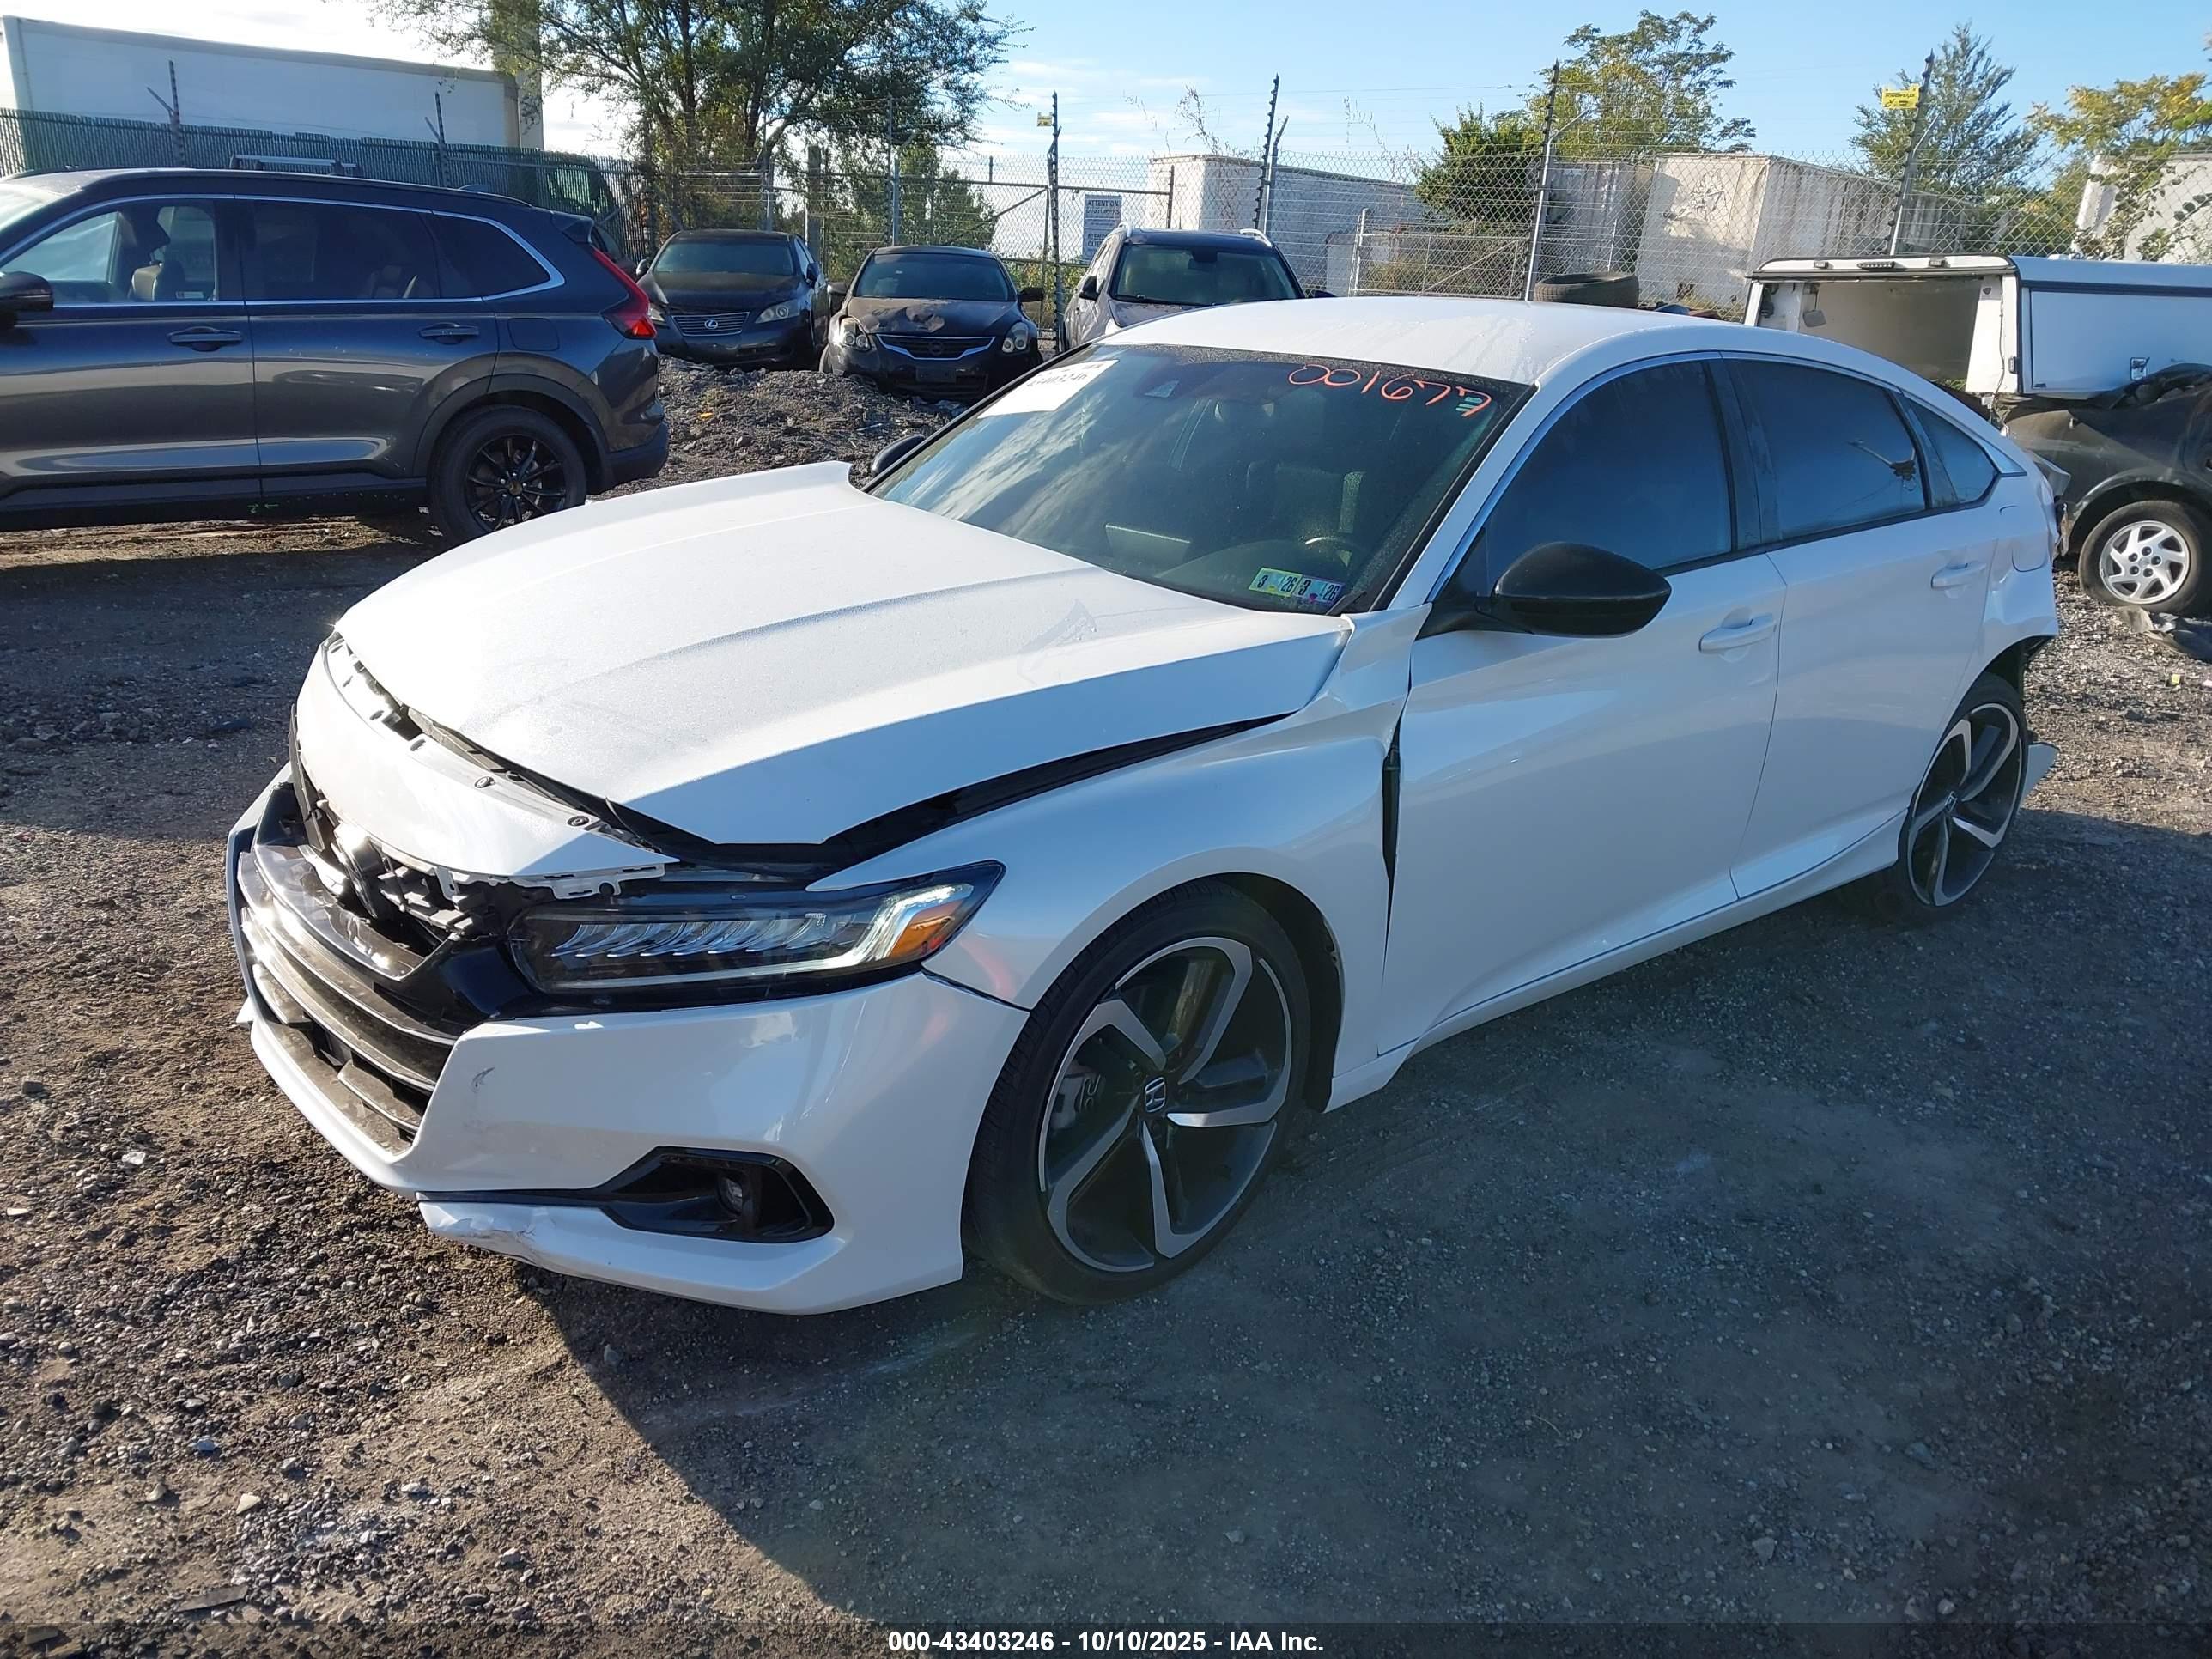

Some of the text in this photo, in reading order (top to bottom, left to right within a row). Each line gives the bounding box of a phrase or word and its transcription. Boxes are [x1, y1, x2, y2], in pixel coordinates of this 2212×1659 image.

[1257, 575, 1297, 592] 3 26
[1323, 584, 1340, 601] 26
